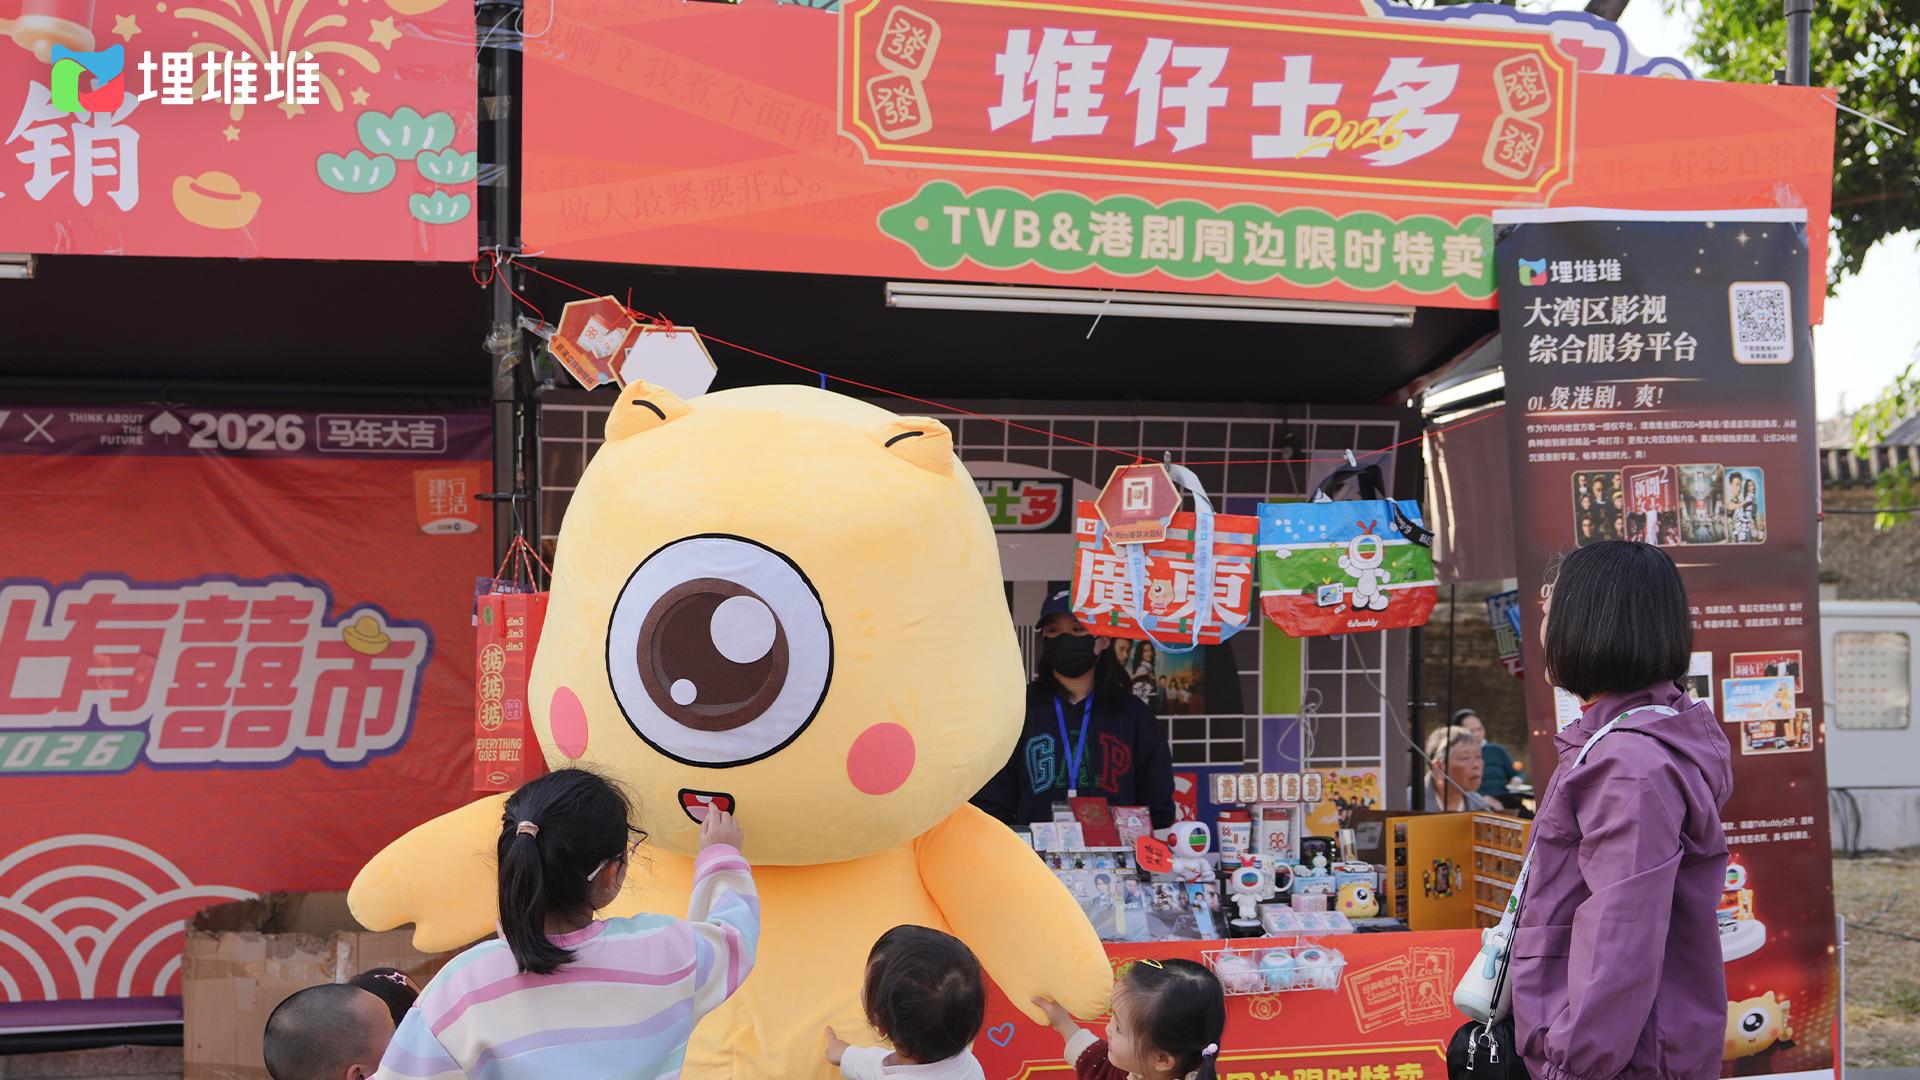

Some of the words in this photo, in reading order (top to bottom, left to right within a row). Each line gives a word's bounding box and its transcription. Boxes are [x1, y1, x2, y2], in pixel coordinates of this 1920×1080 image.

[988, 27, 1461, 167] 堆仔士多
[1, 80, 141, 212] 销
[1296, 108, 1411, 160] 2026
[943, 205, 1485, 280] TVB&港剧周边限时特卖
[1550, 258, 1622, 284] 埋堆堆
[1523, 294, 1668, 328] 大湾区影视
[1529, 331, 1698, 365] 综合服务平台
[69, 412, 104, 423] THINK
[106, 413, 144, 424] ABOUT
[122, 425, 144, 434] THE
[188, 413, 306, 451] 2026
[100, 435, 144, 446] FUTURE
[327, 419, 437, 449] 马年大吉
[428, 496, 468, 516] 生活
[506, 617, 524, 627] dim3
[506, 641, 524, 652] dim3
[0, 735, 125, 769] 026
[477, 738, 522, 750] EVERYTHING
[478, 750, 498, 762] GOES
[499, 750, 520, 762] WELL
[1026, 730, 1133, 795] GAP
